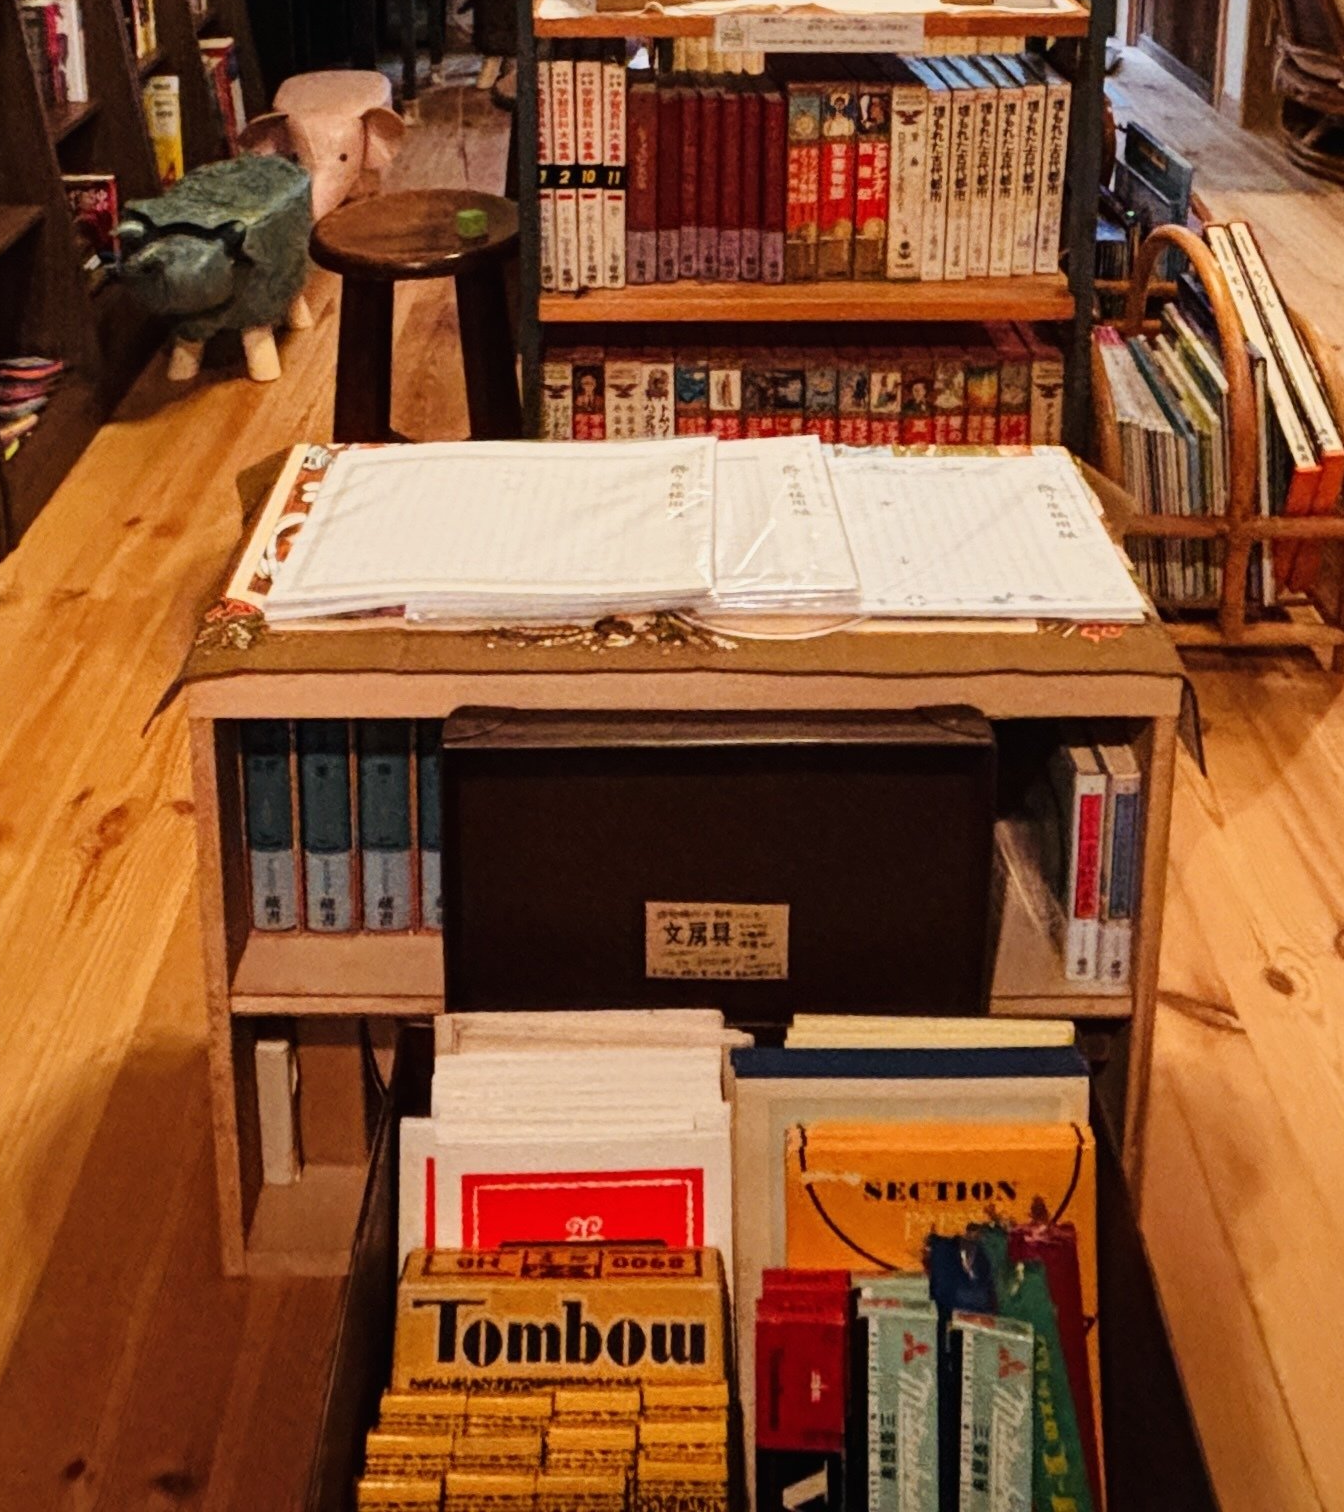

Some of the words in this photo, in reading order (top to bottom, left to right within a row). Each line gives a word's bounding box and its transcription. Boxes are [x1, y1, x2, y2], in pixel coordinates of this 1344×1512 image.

[559, 171, 571, 185] 2
[582, 170, 597, 184] 10
[607, 171, 621, 186] 11
[929, 104, 947, 203] 埋もれた古代都市
[953, 103, 972, 202] 埋もれた古代都市
[998, 101, 1017, 199] 埋もれた古代都市
[1021, 98, 1040, 197] 埋もれた古代都市
[1045, 98, 1065, 196] 埋もれた古代都市
[663, 921, 734, 947] 文房具
[863, 1180, 1020, 1202] SECTION
[412, 1298, 707, 1367] Tombow
